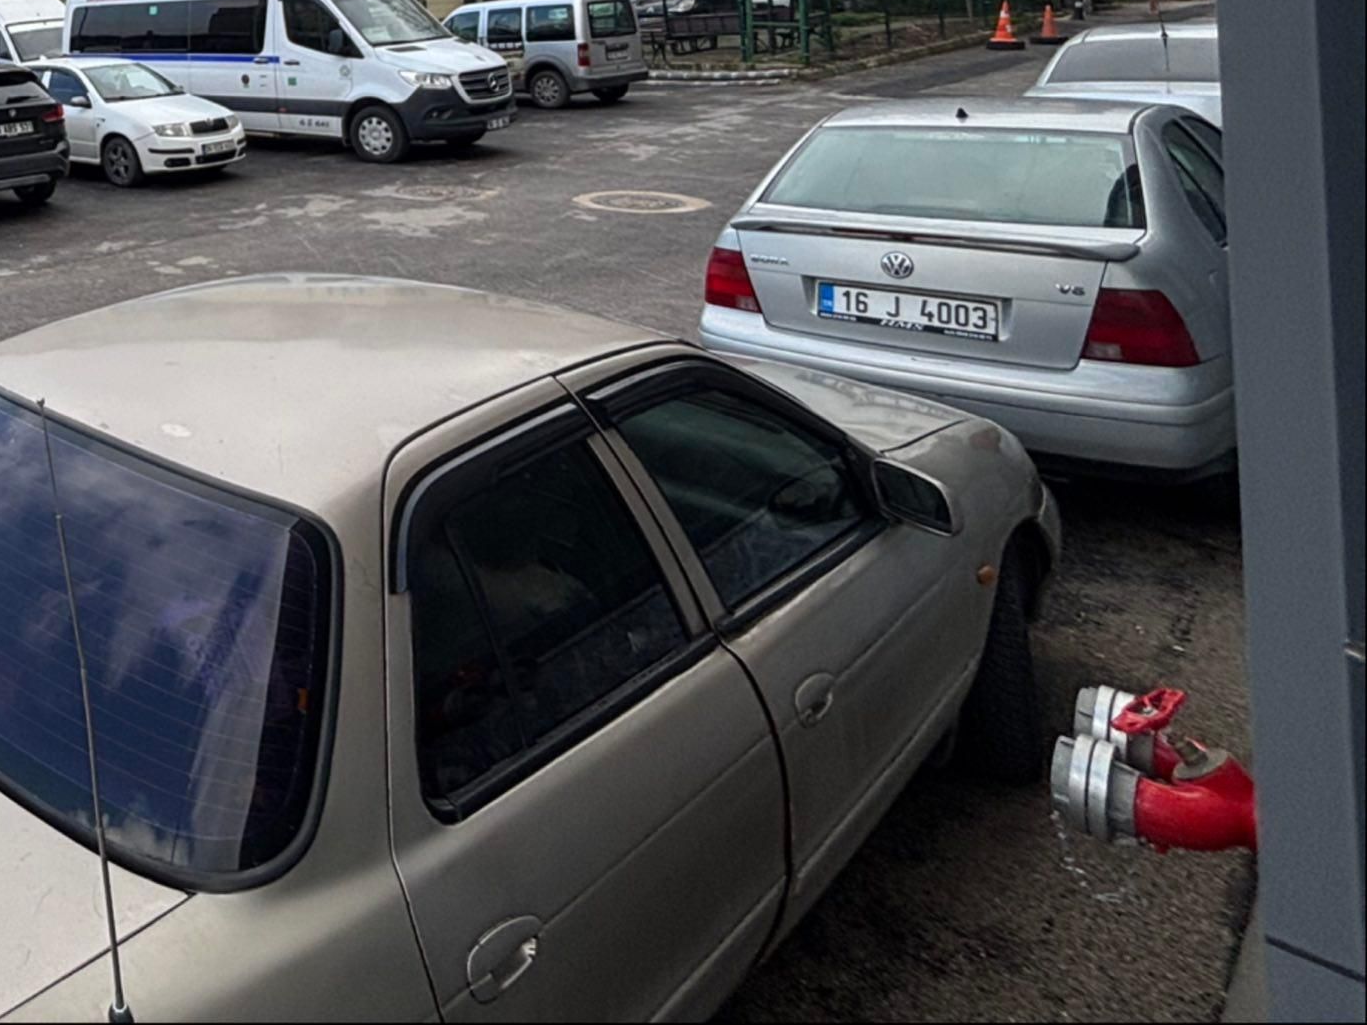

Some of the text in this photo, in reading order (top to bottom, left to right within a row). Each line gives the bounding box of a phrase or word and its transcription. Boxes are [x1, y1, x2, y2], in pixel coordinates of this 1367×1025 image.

[842, 290, 988, 329] 16 J 4003
